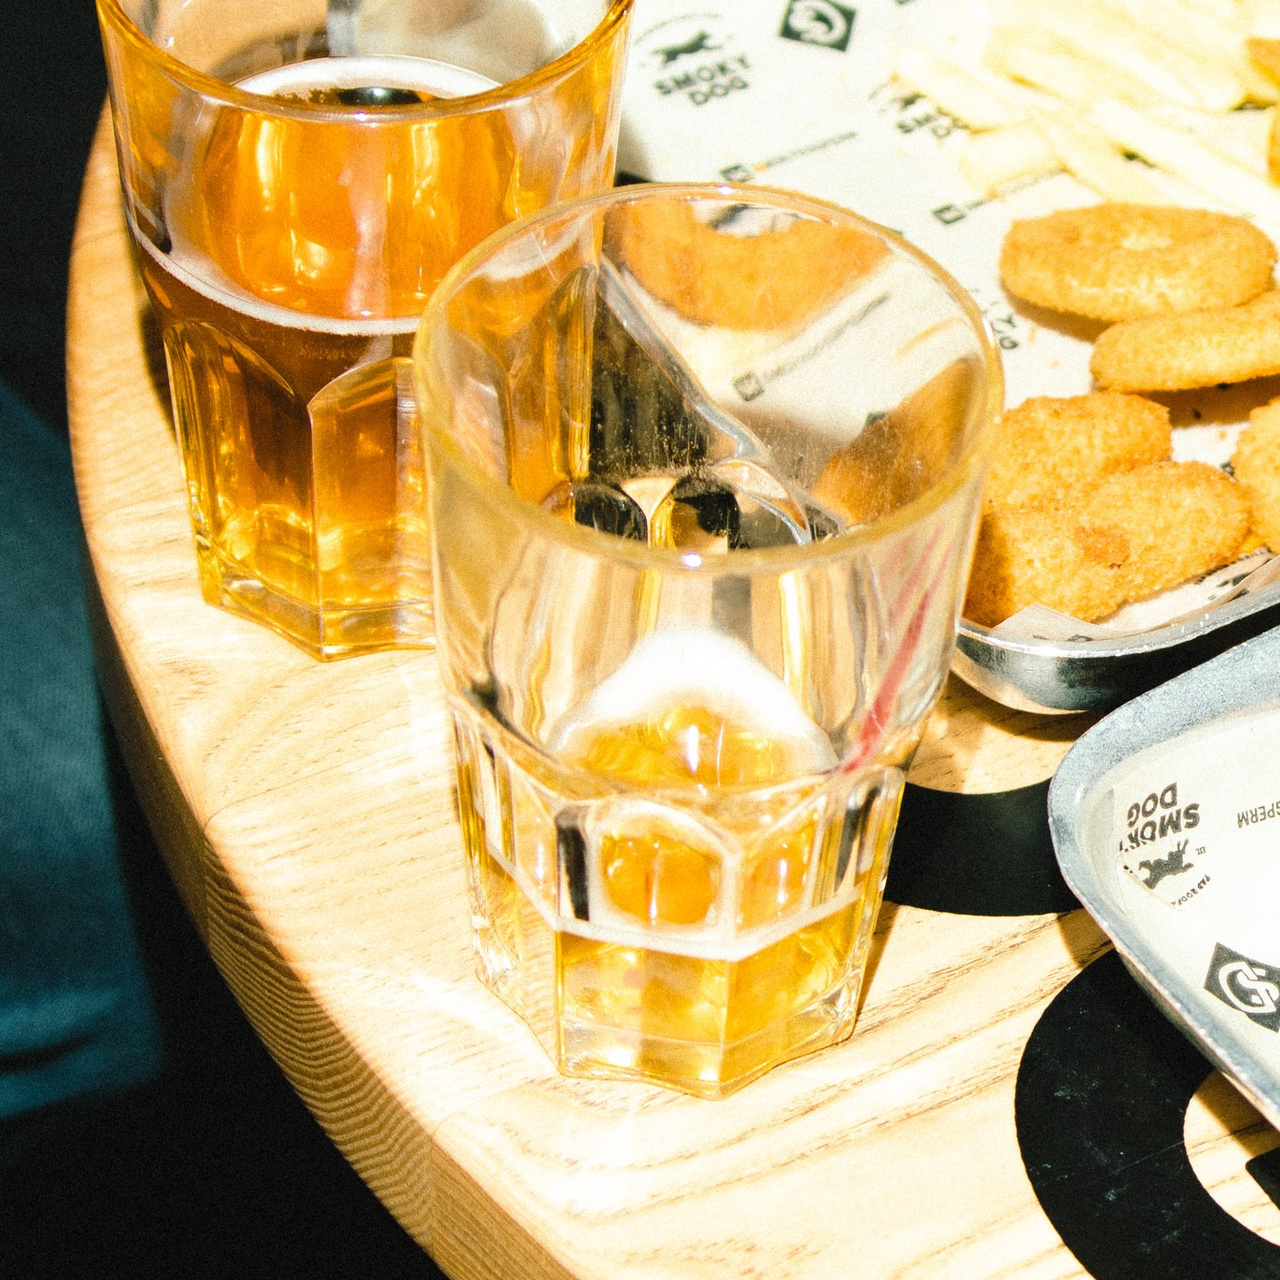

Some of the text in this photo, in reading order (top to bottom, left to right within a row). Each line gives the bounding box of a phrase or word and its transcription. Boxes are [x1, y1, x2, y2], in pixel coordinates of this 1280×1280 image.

[653, 53, 751, 97] SMOKY
[688, 76, 750, 107] DOG
[1127, 782, 1178, 828] DOG
